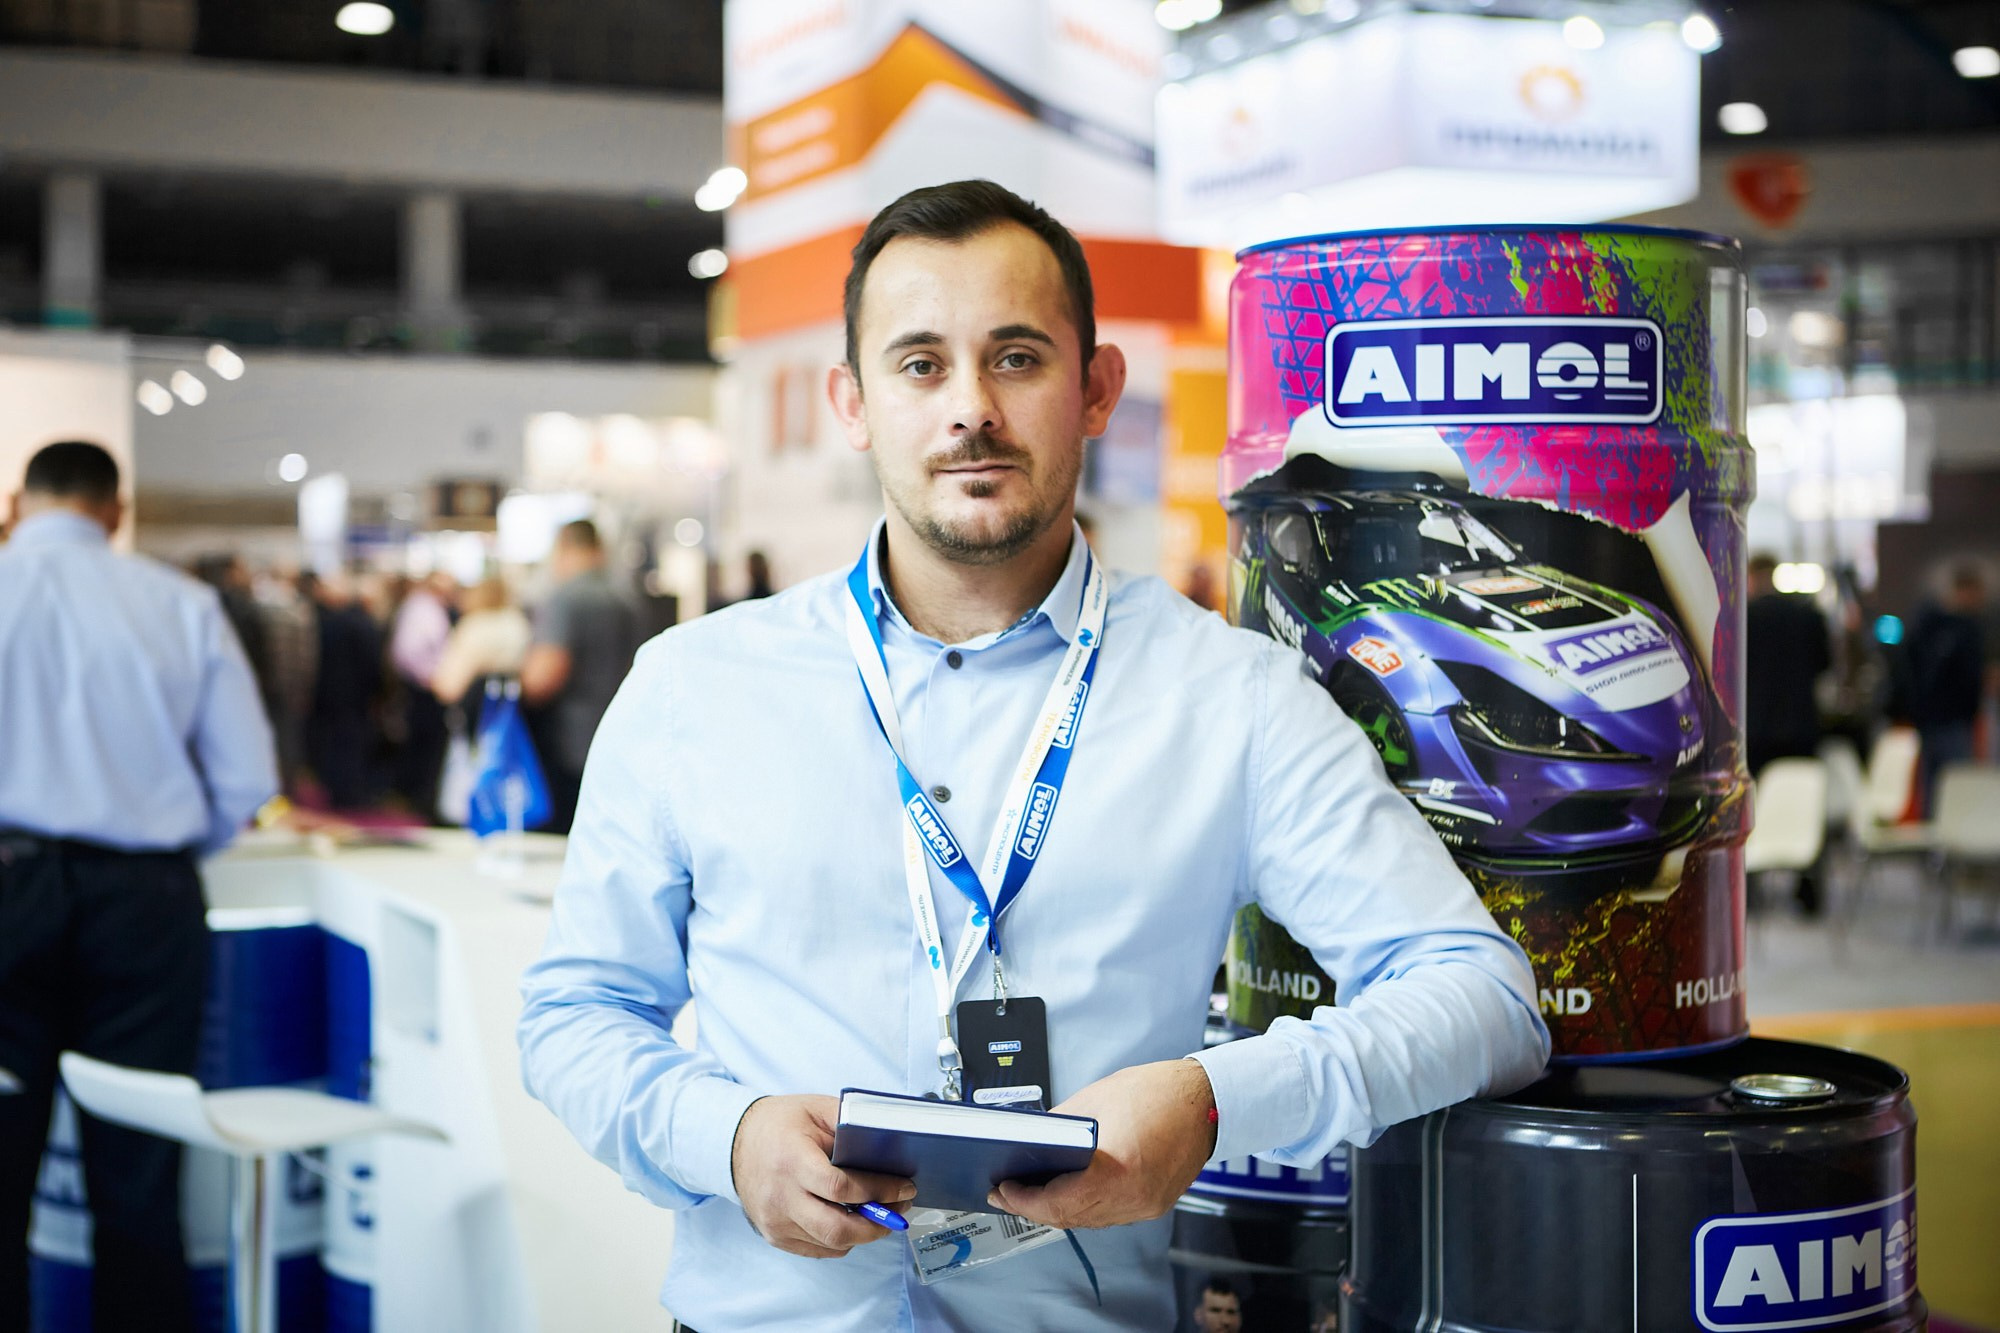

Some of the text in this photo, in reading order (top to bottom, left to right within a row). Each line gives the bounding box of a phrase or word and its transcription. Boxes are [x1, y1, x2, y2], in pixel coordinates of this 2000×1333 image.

[908, 801, 956, 864] AIMOL
[1021, 789, 1053, 856] AIMOL
[1233, 959, 1321, 1001] OLLAND
[929, 1222, 978, 1244] EXHIBITOR
